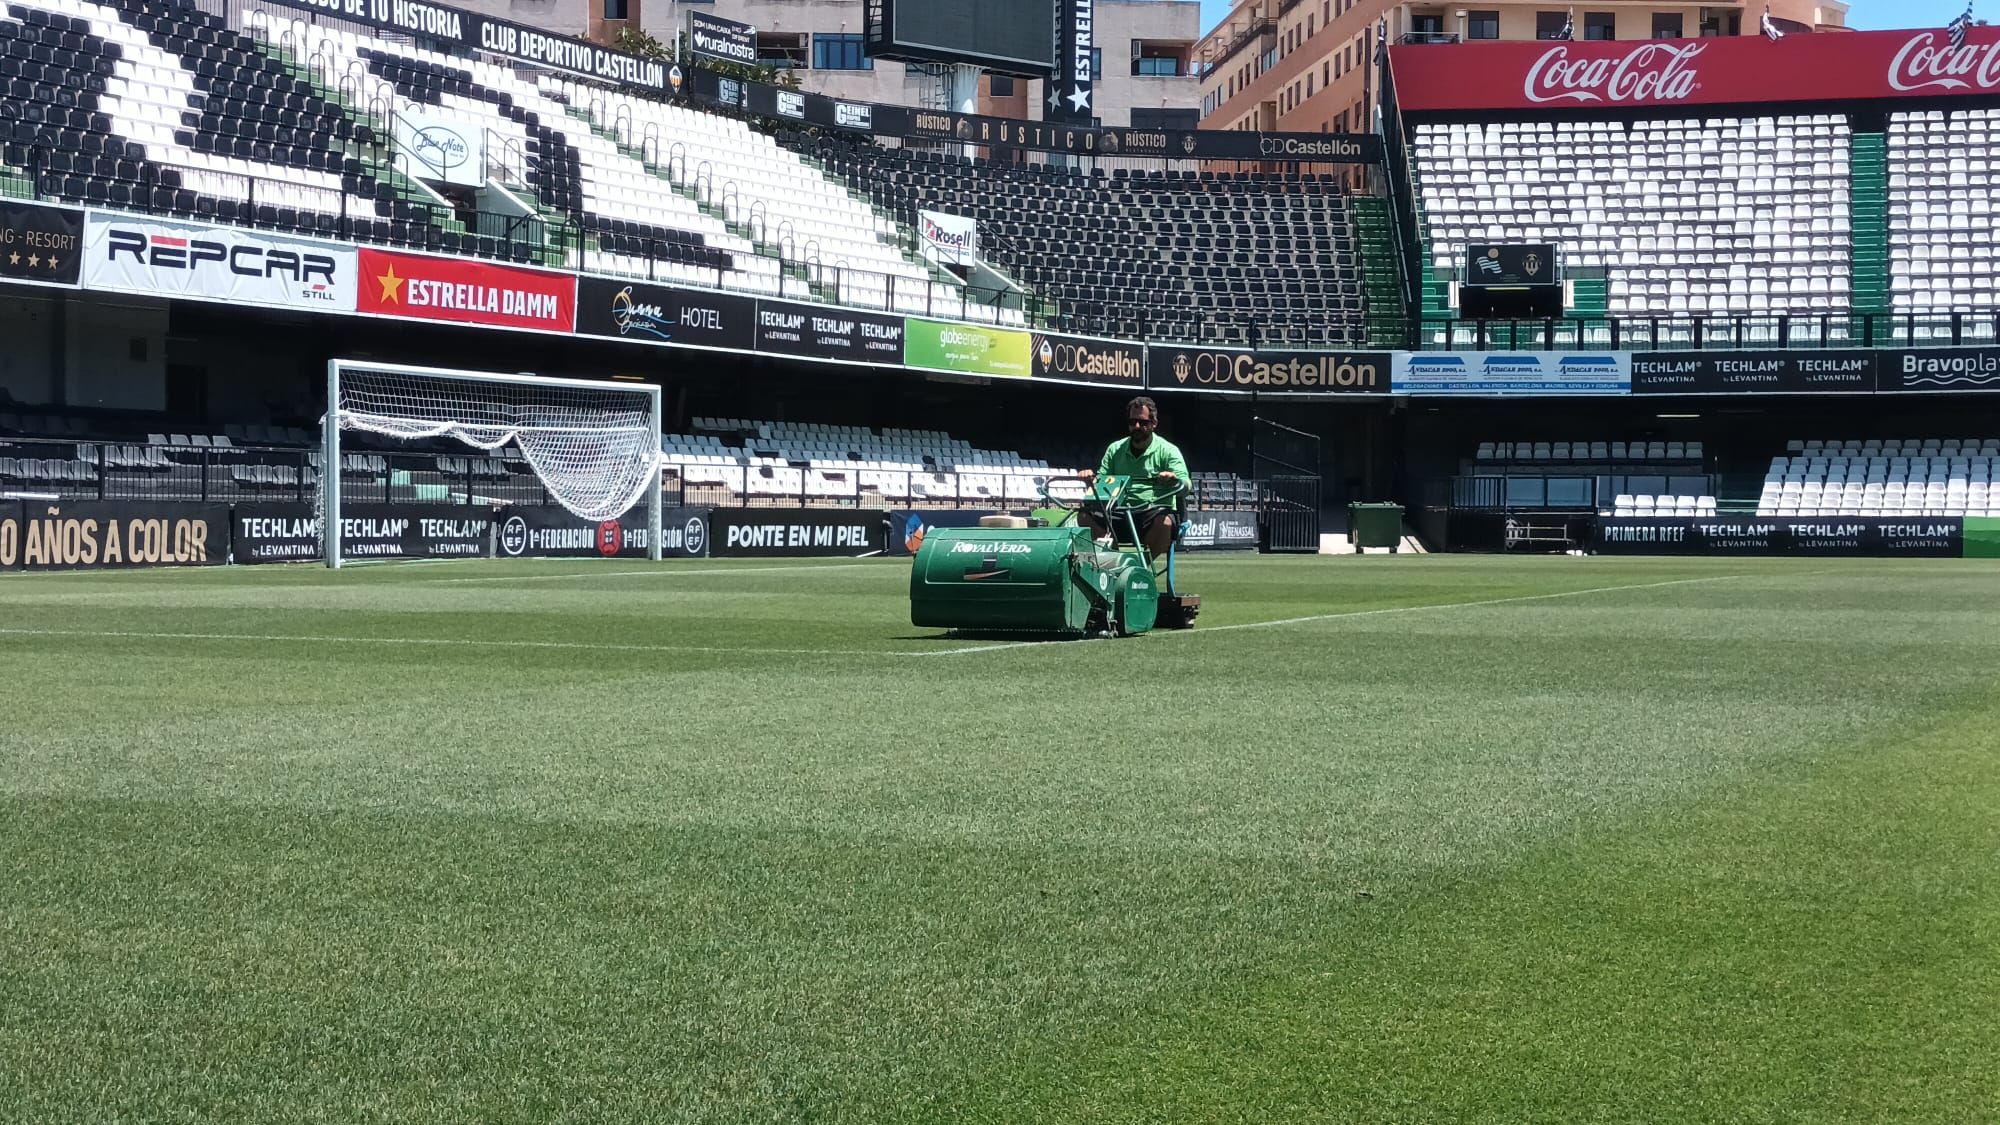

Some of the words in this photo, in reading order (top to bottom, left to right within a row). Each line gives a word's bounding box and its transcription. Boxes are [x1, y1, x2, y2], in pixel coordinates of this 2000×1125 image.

[370, 0, 389, 22] TU
[393, 1, 462, 40] HISTORIA
[482, 21, 517, 54] CLUB
[520, 30, 592, 72] DEPORTIVO
[595, 50, 664, 89] CASTELLÓN
[704, 36, 755, 60] ruralnostra
[1524, 42, 1708, 102] Coca-Cola
[916, 112, 951, 131] RÚSTICO
[1125, 130, 1166, 148] RÚSTICO
[26, 230, 76, 251] RESORT
[936, 227, 971, 247] Rosell
[108, 229, 336, 285] REPCAR
[302, 290, 336, 301] STILL
[407, 278, 499, 314] ESTRELLA
[502, 290, 558, 320] DAMM
[681, 306, 724, 330] HOTEL
[769, 331, 801, 342] LEVANTINA
[822, 336, 851, 347] LEVANTINA
[870, 341, 898, 351] LEVANTINA
[1903, 352, 2000, 377] Bravopla
[1648, 375, 1695, 383] LEVANTINA
[24, 506, 98, 565] AÑOS
[103, 519, 122, 564] A
[128, 518, 208, 563] COLOR
[540, 525, 595, 549] FEDERACIÓN
[727, 525, 785, 548] PONTE
[788, 525, 811, 547] EN
[814, 525, 833, 547] MI
[836, 525, 869, 547] PIEL
[1185, 518, 1216, 537] Rosell
[1605, 526, 1656, 542] PRIMERA
[1659, 526, 1685, 542] RFEF
[260, 544, 315, 555] LEVANTINA
[352, 544, 403, 554] LEVANTINA
[435, 543, 480, 554] LEVANTINA
[1896, 540, 1949, 548] LEVANTINA
